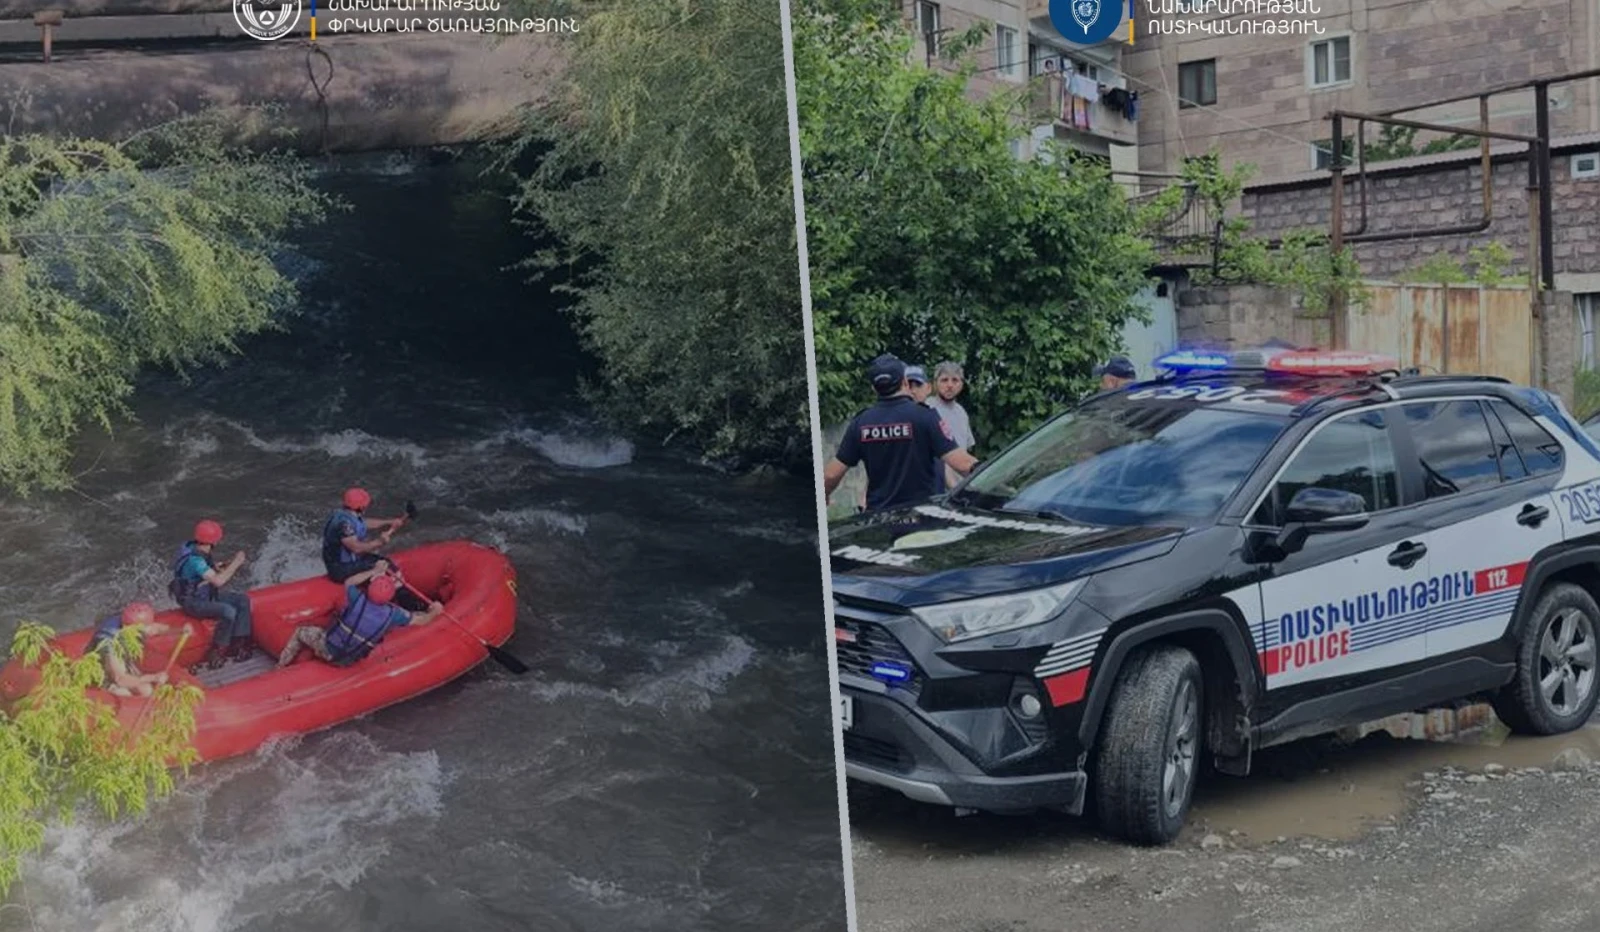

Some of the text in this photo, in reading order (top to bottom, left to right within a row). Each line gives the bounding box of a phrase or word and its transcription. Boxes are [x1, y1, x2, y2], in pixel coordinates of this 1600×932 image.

[862, 425, 910, 439] POLICE
[1560, 483, 1600, 521] 205
[1487, 568, 1507, 589] 112
[1280, 570, 1475, 643] ՈՍՏԻԿԱՆՈՒԹՅՈՒՆ
[1280, 629, 1350, 673] POLICE
